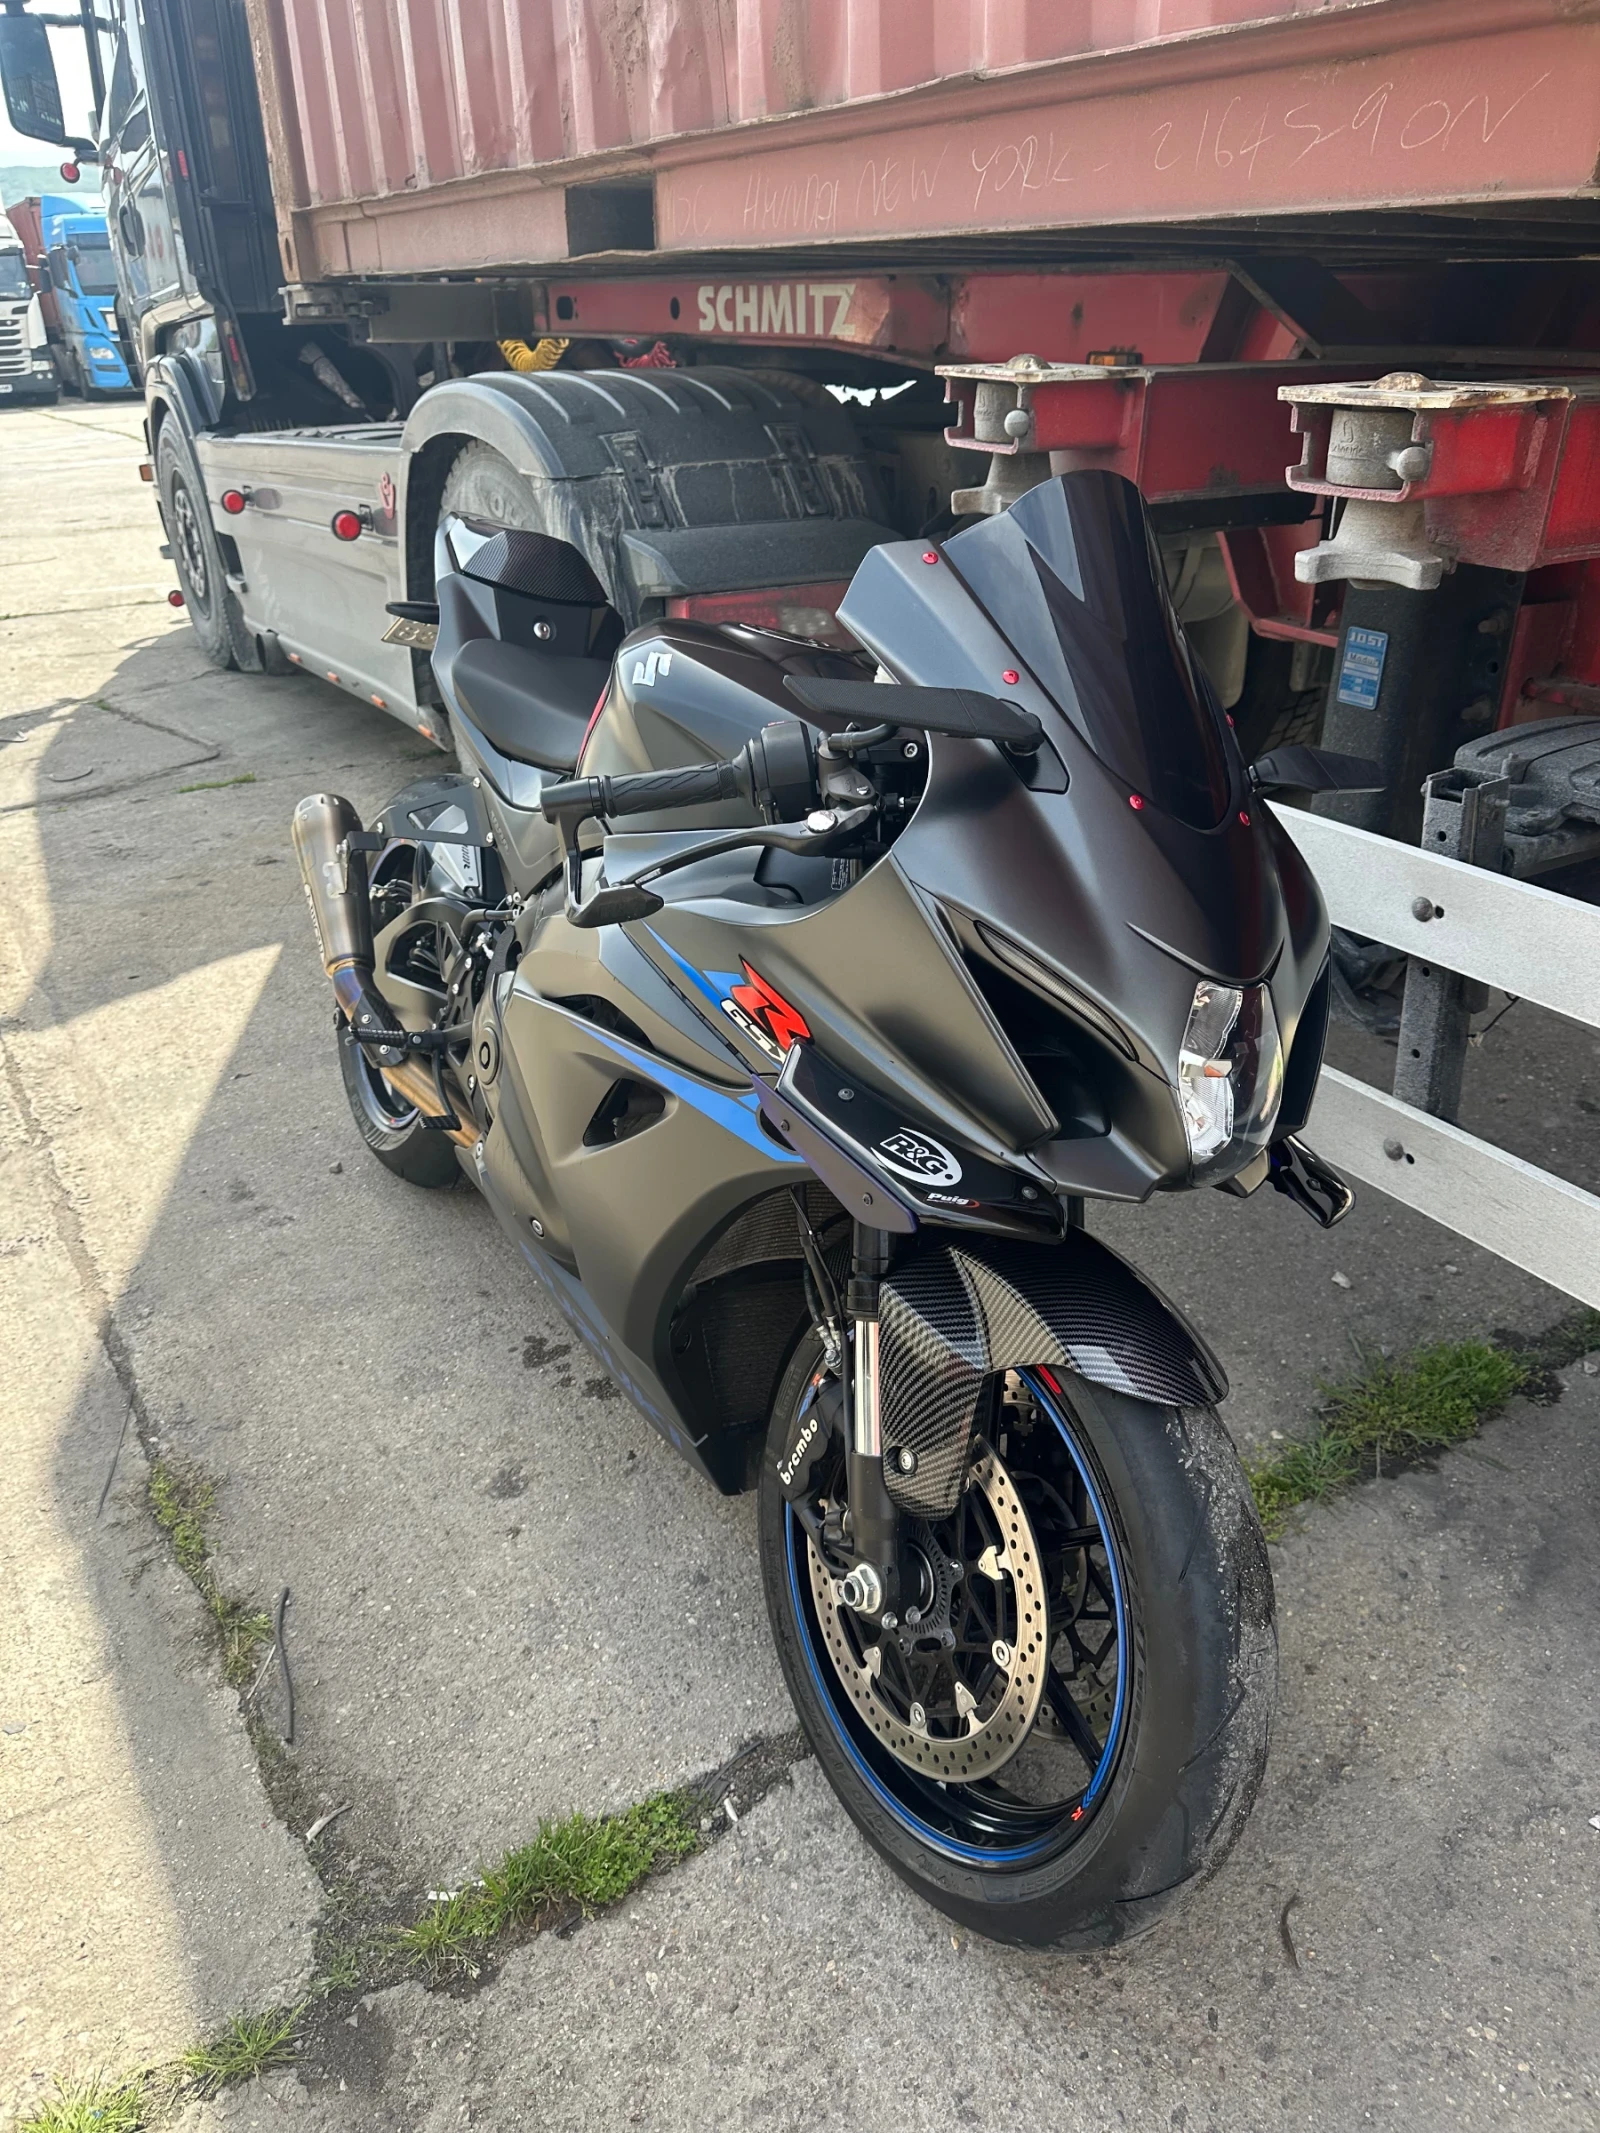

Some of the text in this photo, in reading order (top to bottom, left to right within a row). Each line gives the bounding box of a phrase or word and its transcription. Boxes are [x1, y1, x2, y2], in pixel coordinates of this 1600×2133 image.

[855, 141, 950, 217] NEW
[972, 132, 1074, 212] YORK
[697, 284, 857, 336] SCHMITZ
[1349, 632, 1384, 647] JOST
[927, 1192, 970, 1206] Puig
[780, 1418, 818, 1485] brembo
